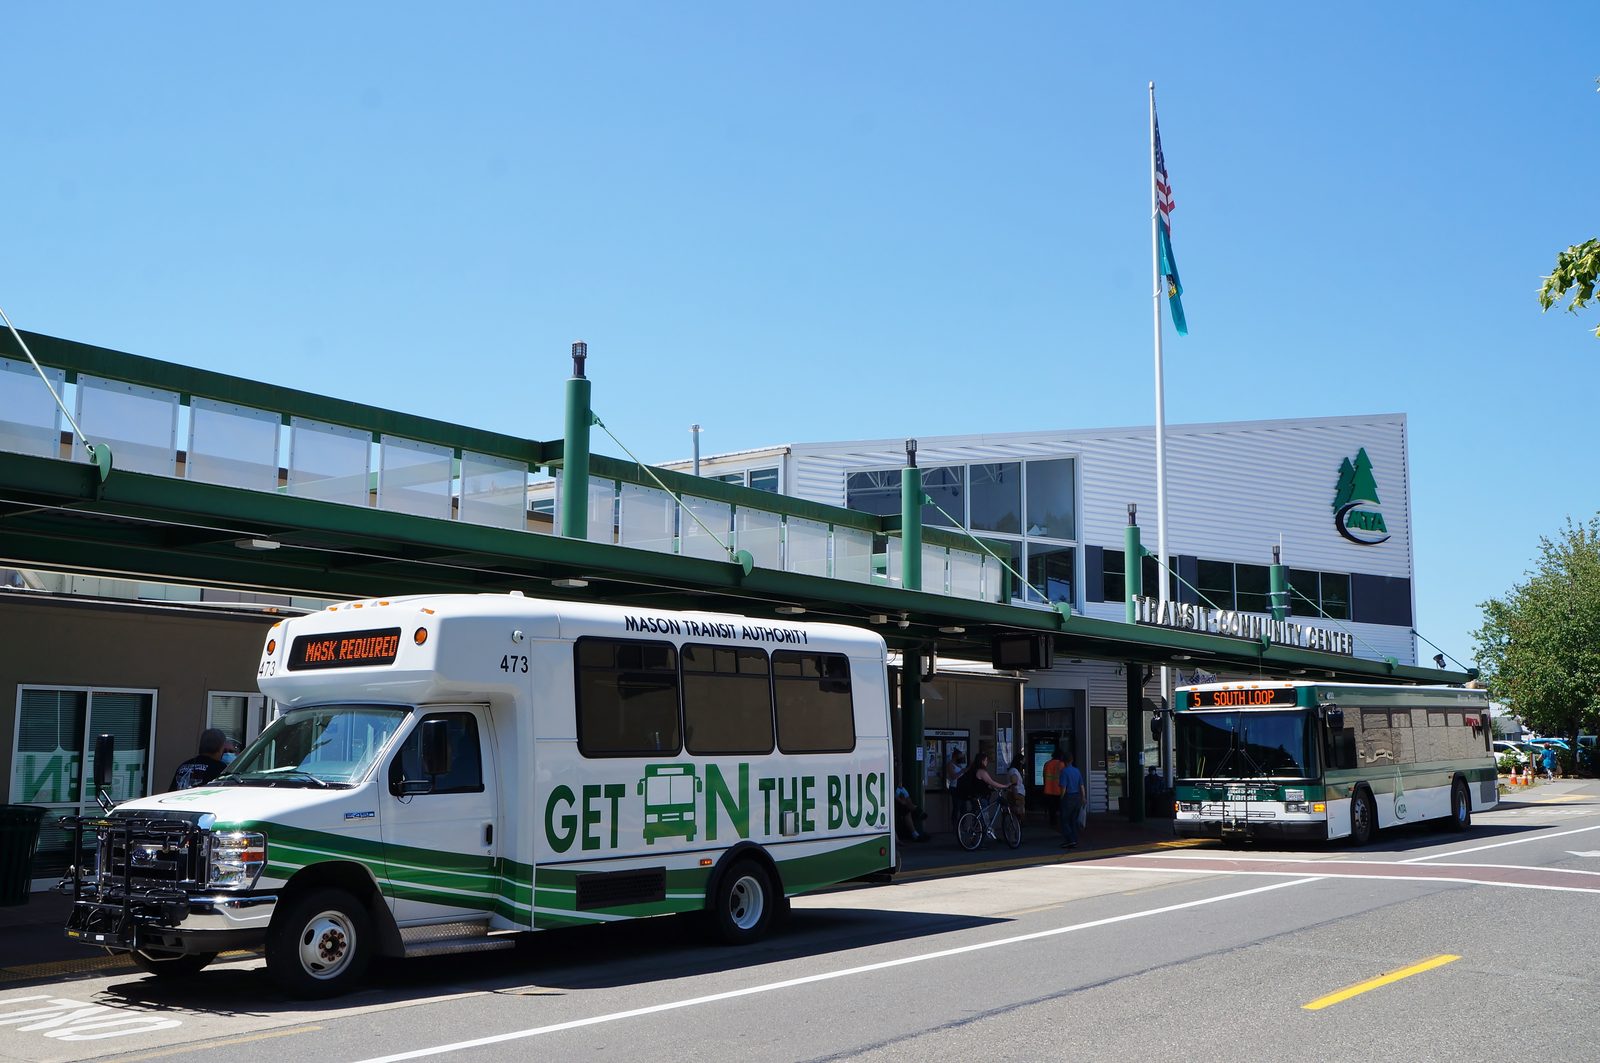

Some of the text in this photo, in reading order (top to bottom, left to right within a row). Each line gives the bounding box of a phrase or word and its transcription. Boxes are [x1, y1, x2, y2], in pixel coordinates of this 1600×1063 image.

[1346, 510, 1387, 533] MTA
[624, 615, 808, 644] MASON TRANSIT AUTHORITY
[1306, 626, 1353, 655] CENTER
[305, 635, 398, 662] MASK REQUIRED
[258, 661, 276, 677] 473
[500, 654, 529, 673] 473
[1193, 690, 1275, 707] 5 SOUTH LOOP
[1227, 793, 1257, 801] Transit
[544, 783, 626, 853] GET
[758, 776, 816, 836] THE
[828, 773, 887, 830] BUS!
